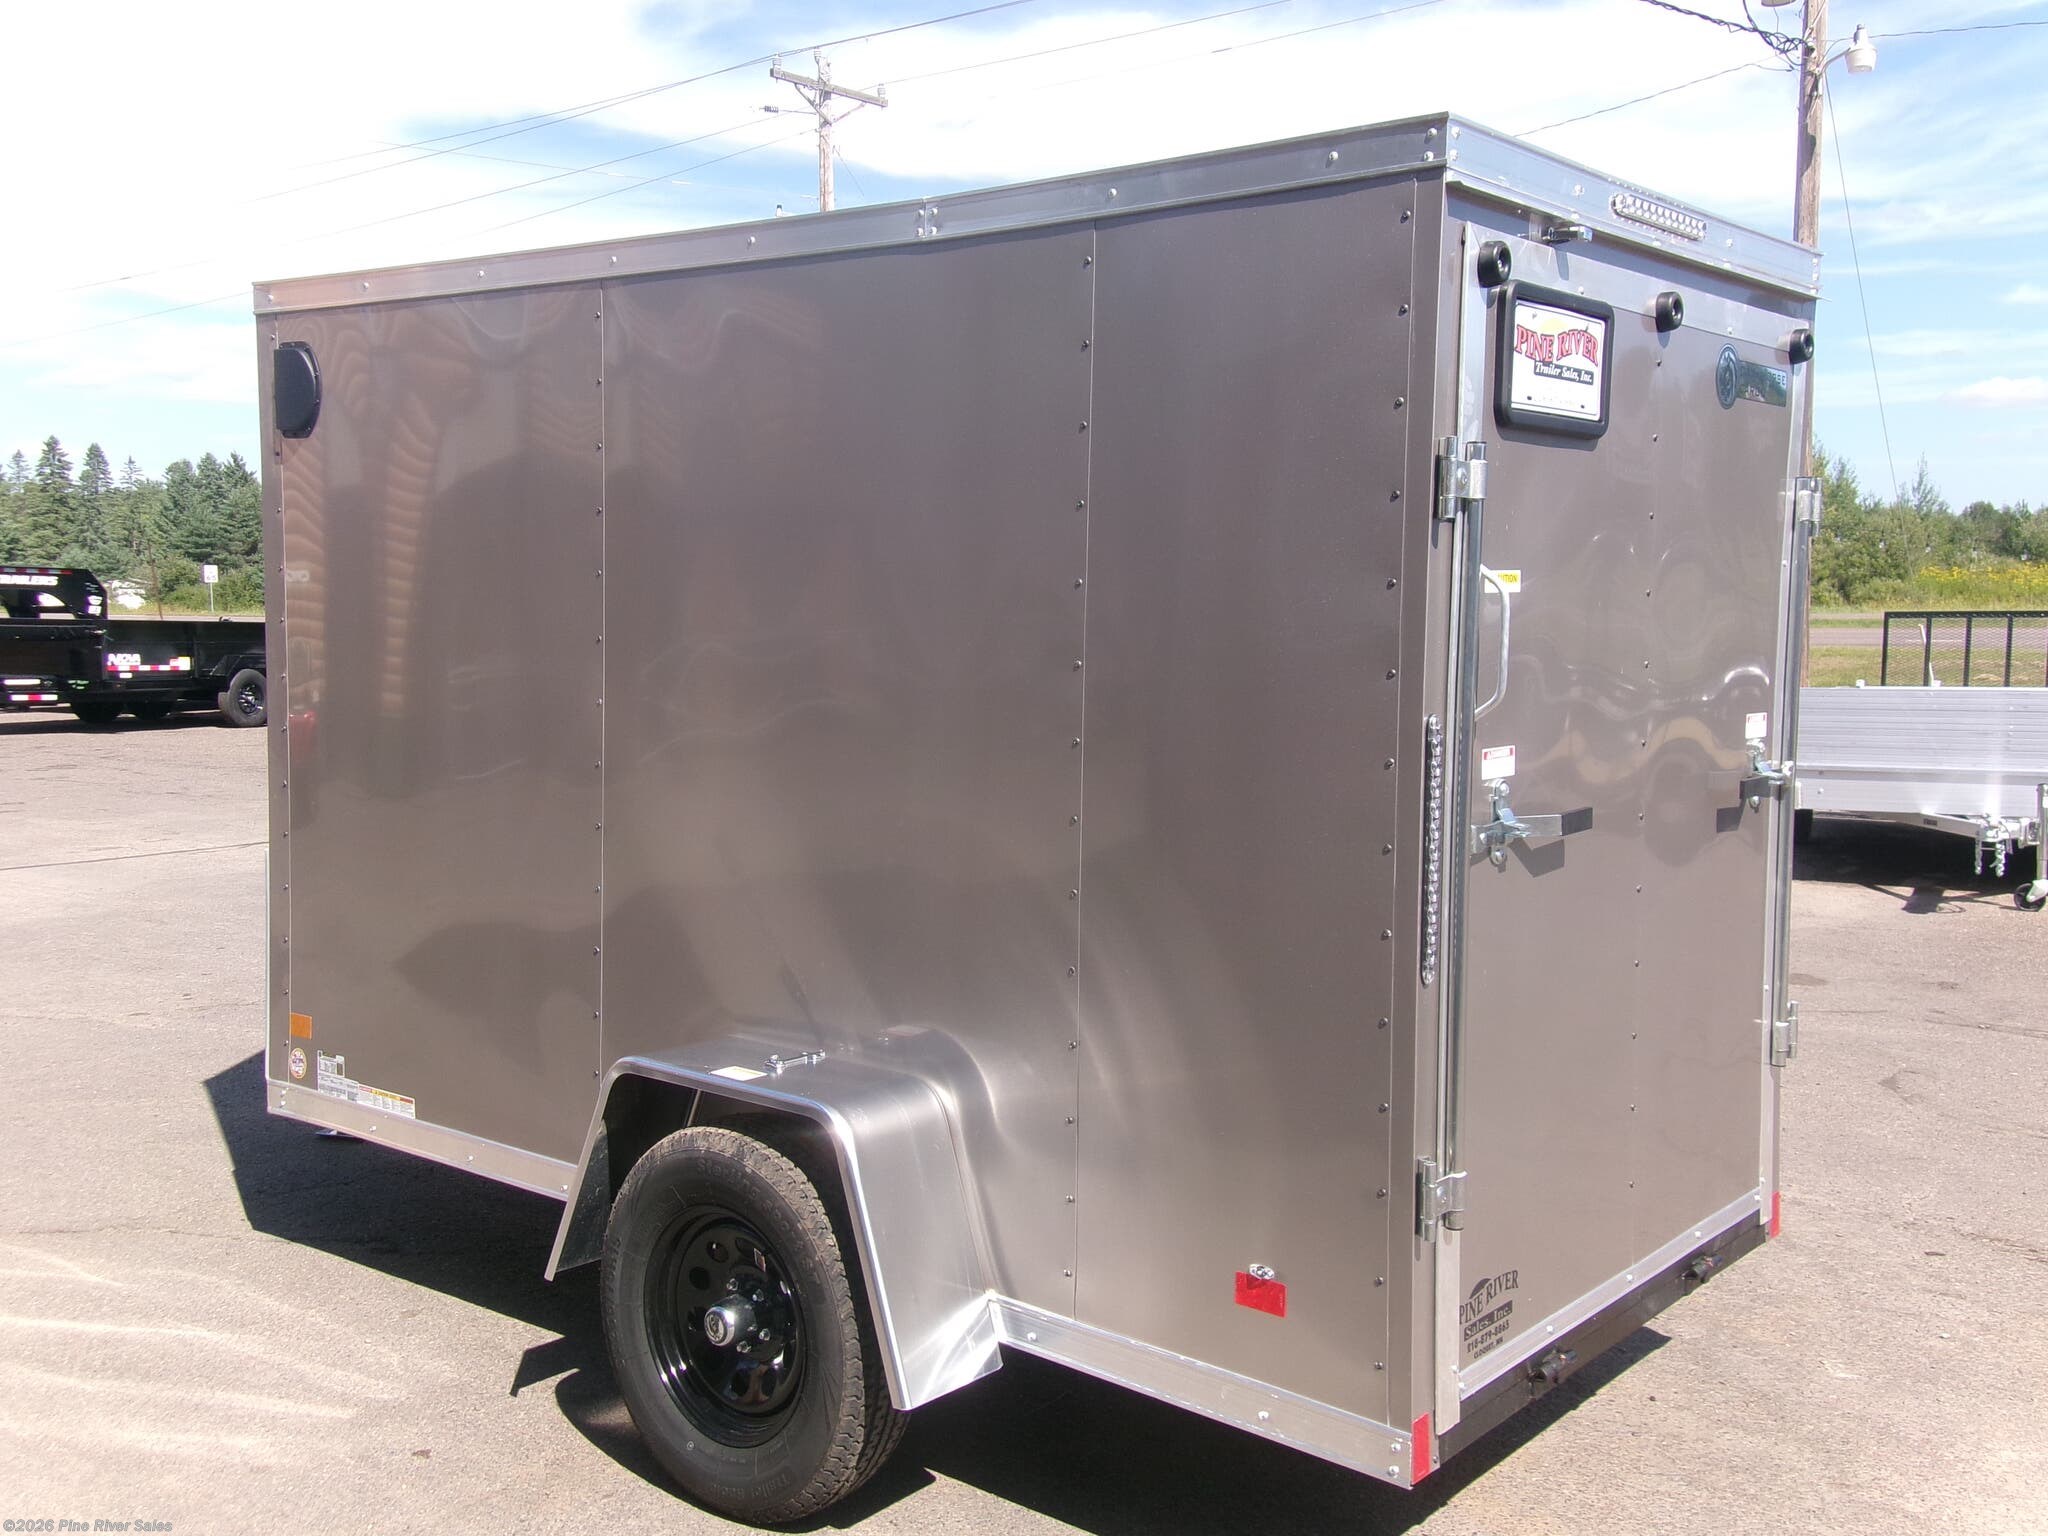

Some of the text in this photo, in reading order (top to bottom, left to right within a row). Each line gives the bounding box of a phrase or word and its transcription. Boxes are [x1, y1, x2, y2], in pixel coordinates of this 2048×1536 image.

[1514, 324, 1598, 367] PINE RIVER
[1535, 361, 1592, 382] Trailer Sales, Inc.
[1459, 1270, 1519, 1325] PINE RIVER
